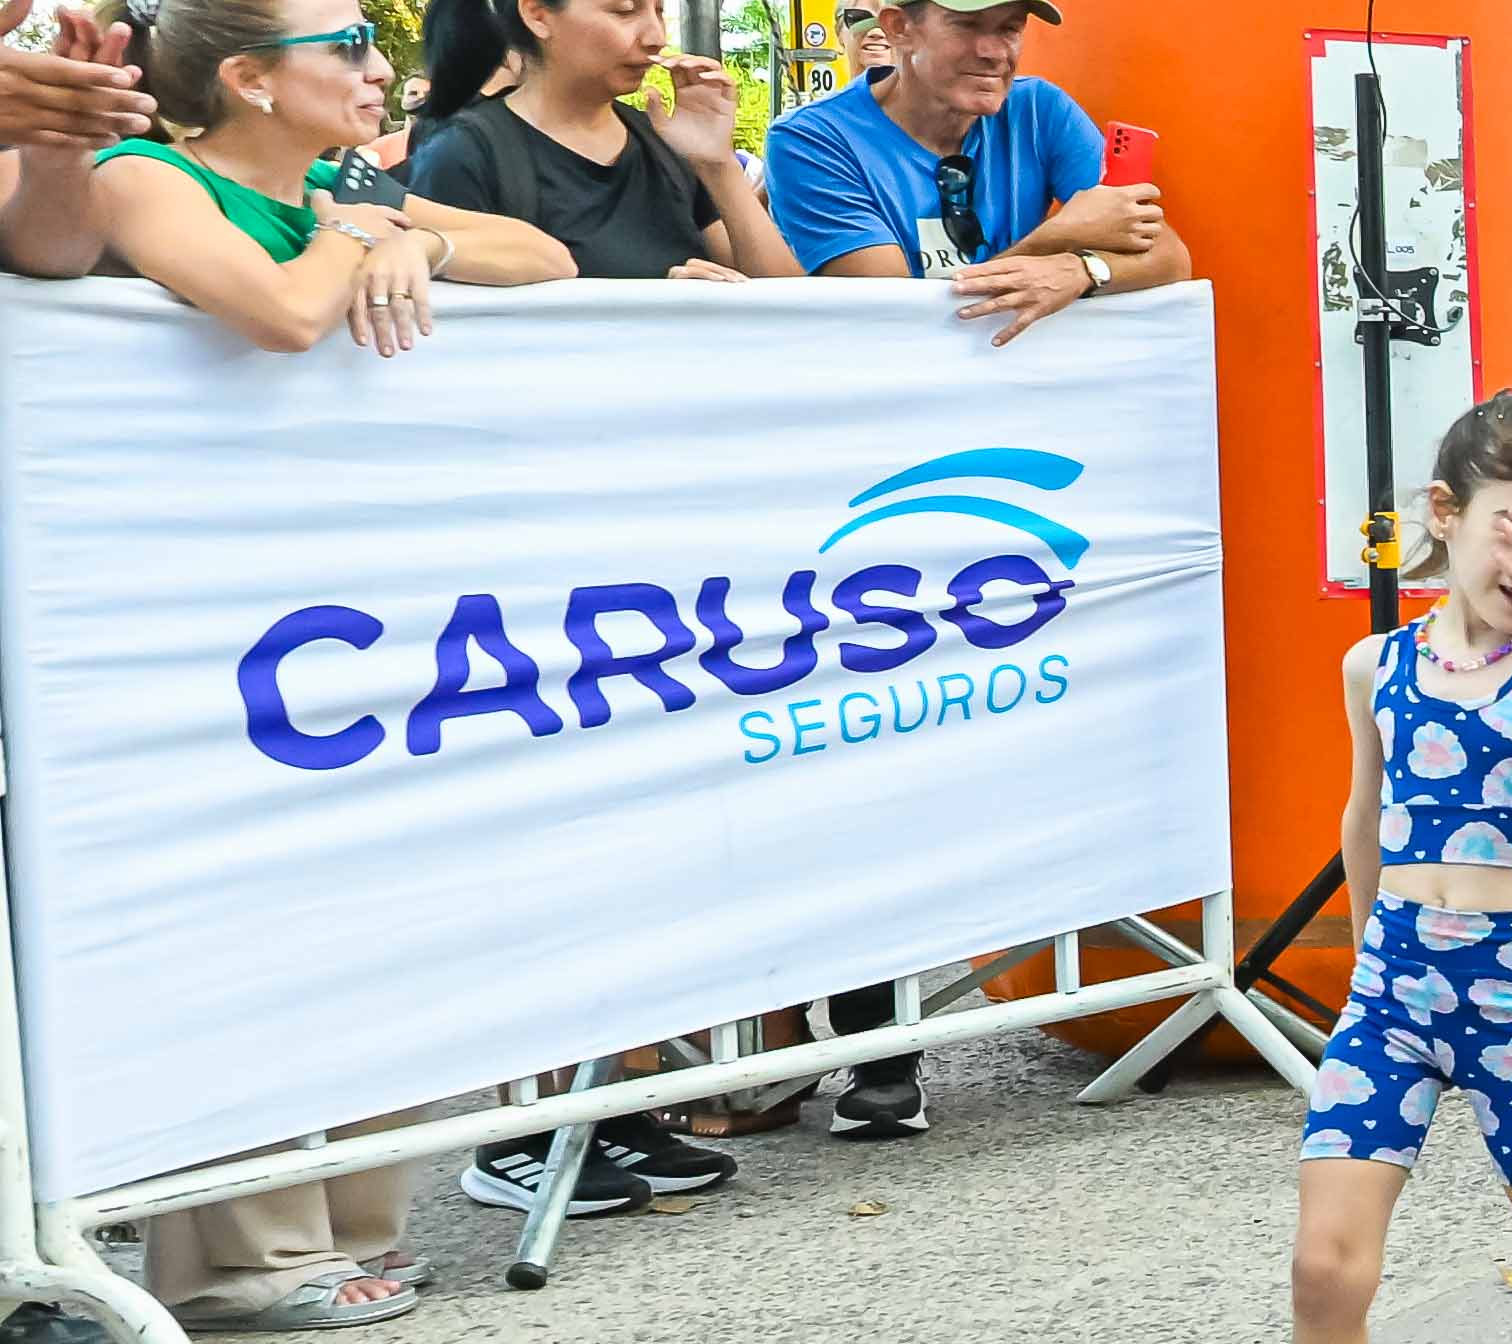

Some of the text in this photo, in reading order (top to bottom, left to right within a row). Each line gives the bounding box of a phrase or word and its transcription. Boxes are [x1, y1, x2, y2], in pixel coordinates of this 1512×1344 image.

[812, 70, 832, 91] 80
[237, 554, 1074, 771] CARUSO
[738, 653, 1072, 766] SEGUROS
